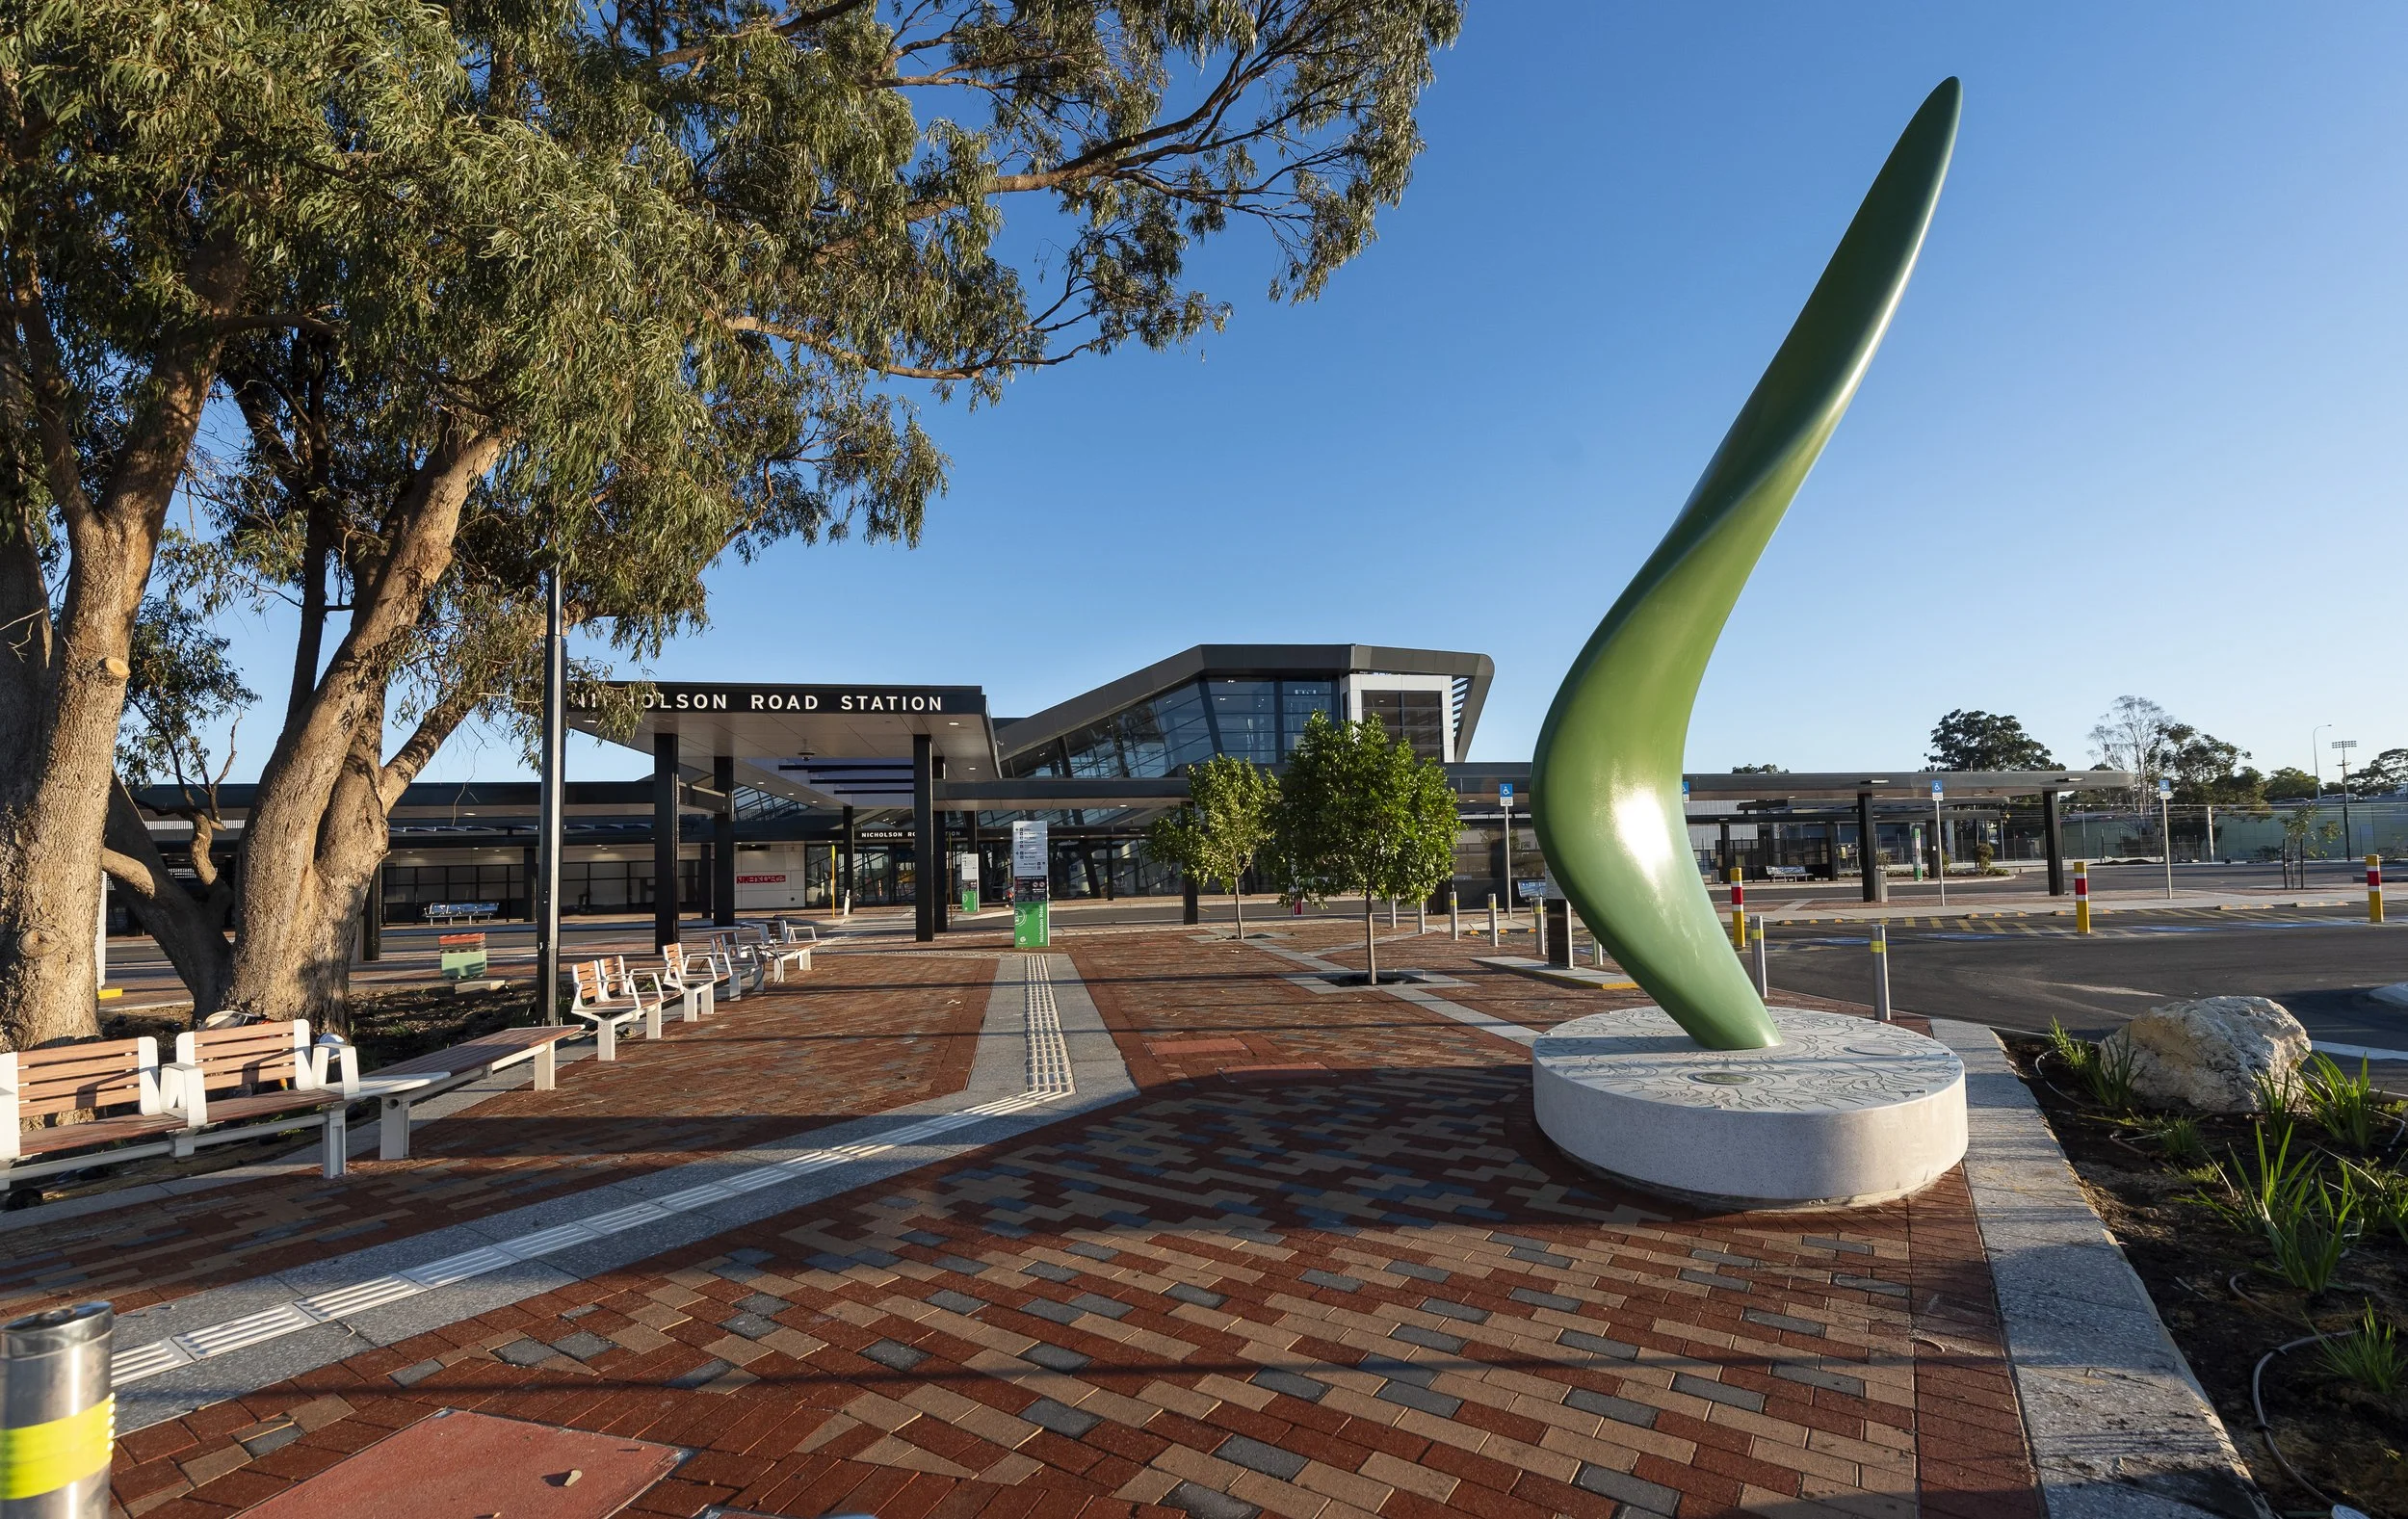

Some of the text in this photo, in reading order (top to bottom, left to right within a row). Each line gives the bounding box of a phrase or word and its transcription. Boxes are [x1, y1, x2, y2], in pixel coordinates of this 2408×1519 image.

[571, 693, 942, 712] NIOLSON ROAD STATION
